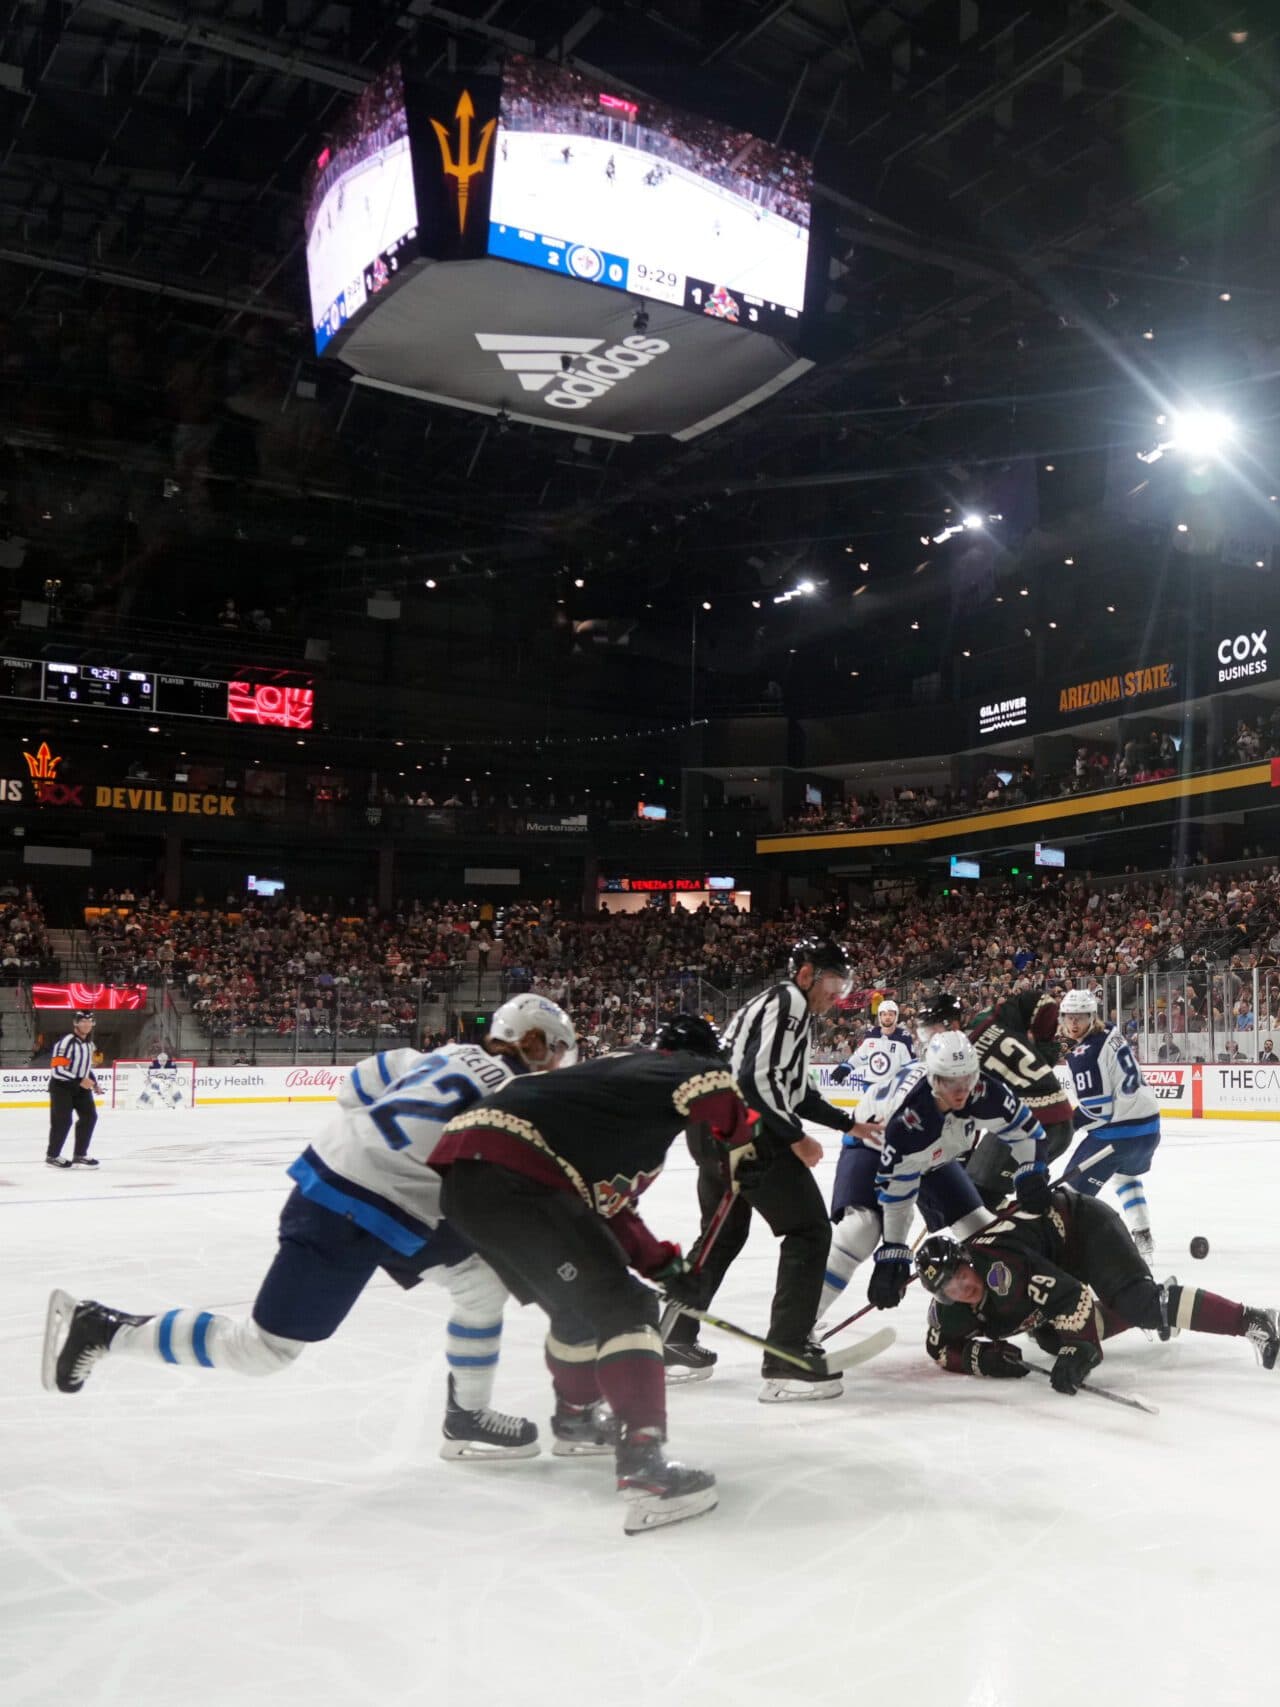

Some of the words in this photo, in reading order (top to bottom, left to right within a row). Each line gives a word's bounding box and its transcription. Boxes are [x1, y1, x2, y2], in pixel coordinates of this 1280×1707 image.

[637, 264, 677, 287] 9:29
[691, 287, 701, 304] 1
[544, 334, 670, 409] adidas
[1217, 629, 1267, 665] COX
[91, 667, 118, 681] 9:29
[1218, 659, 1267, 683] BUSINESS
[142, 683, 151, 694] 0
[1059, 675, 1121, 712] ARIZONA
[1123, 663, 1171, 697] STATE
[980, 703, 1000, 718] GILA
[1000, 696, 1026, 713] RIVER
[95, 786, 167, 812] DEVIL
[172, 792, 236, 817] DECK
[526, 822, 588, 833] Mortenson
[952, 1052, 964, 1061] 55
[984, 1036, 1052, 1089] 12
[3, 1075, 29, 1083] GILA
[31, 1074, 50, 1083] RIV
[227, 1074, 265, 1087] Health
[1075, 1070, 1093, 1091] 81
[1143, 1071, 1177, 1084] ZONA
[1027, 1274, 1057, 1306] 29
